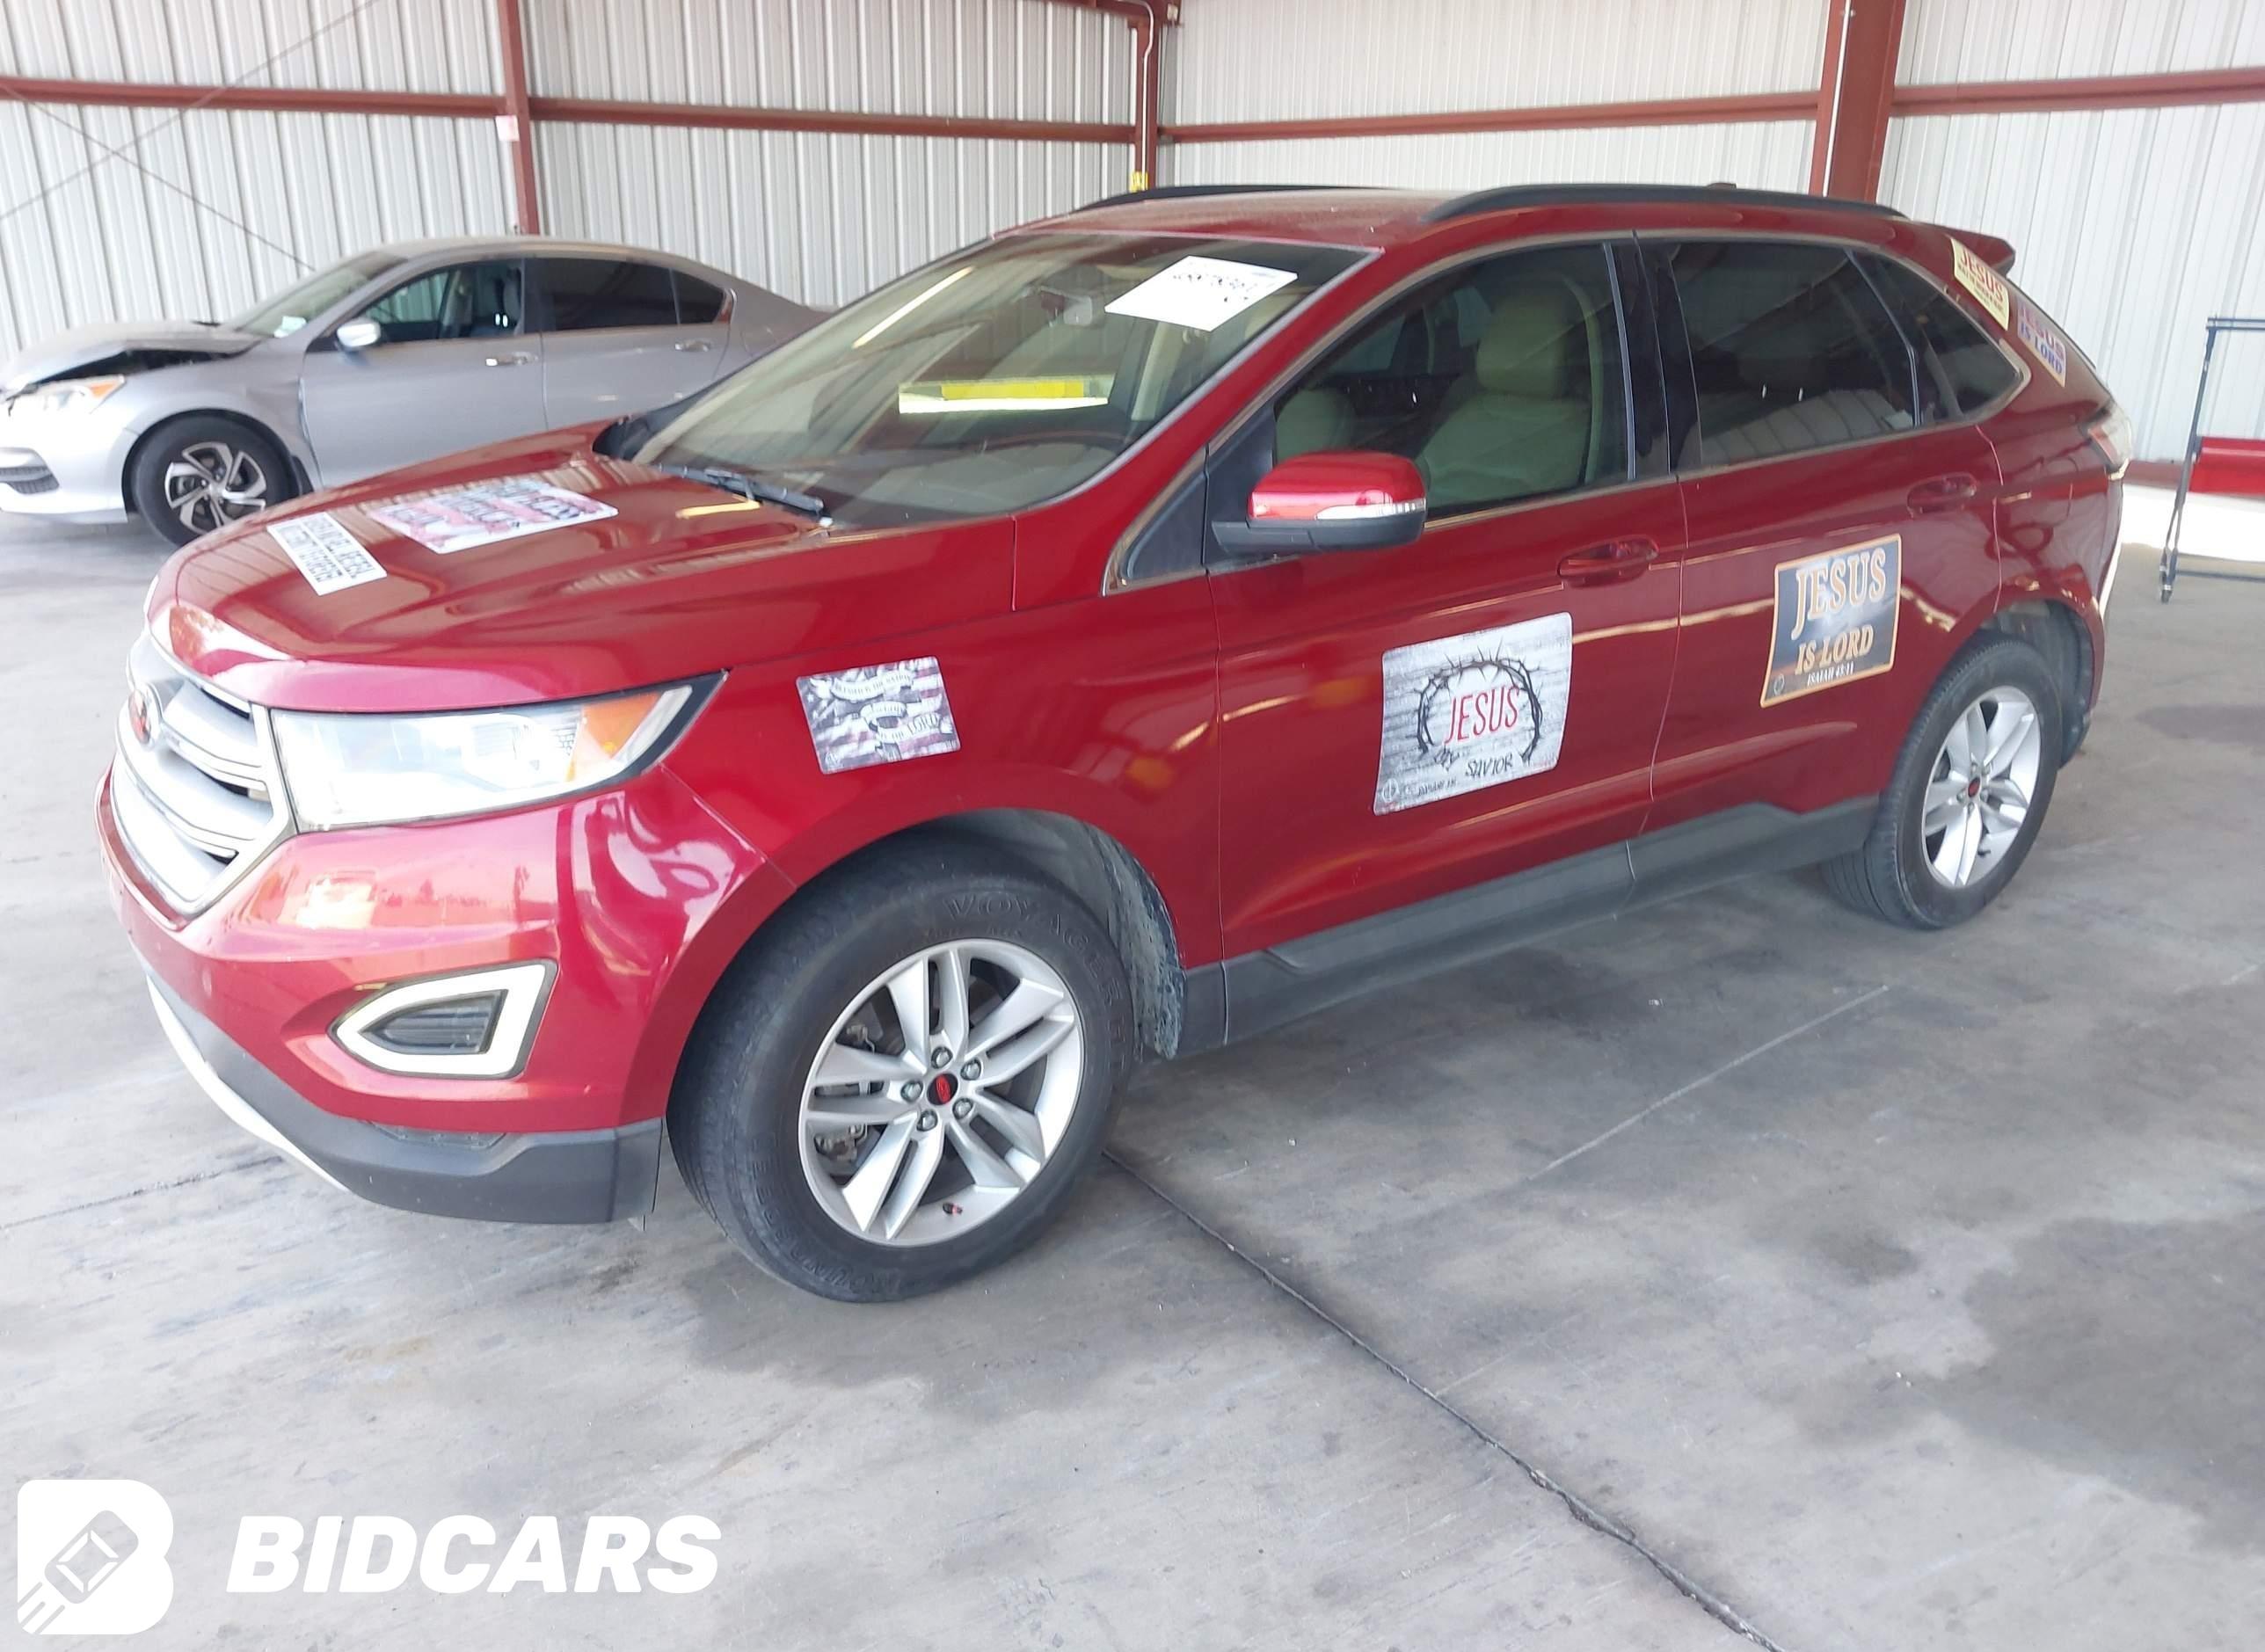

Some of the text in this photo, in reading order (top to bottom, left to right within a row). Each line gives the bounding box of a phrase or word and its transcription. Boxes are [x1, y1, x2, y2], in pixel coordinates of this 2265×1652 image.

[1961, 247, 2005, 303] JESUS
[2034, 334, 2063, 375] LORD
[1790, 547, 1886, 641] JESUS
[1795, 624, 1874, 675] IS LORD
[1444, 686, 1520, 746] JESUS
